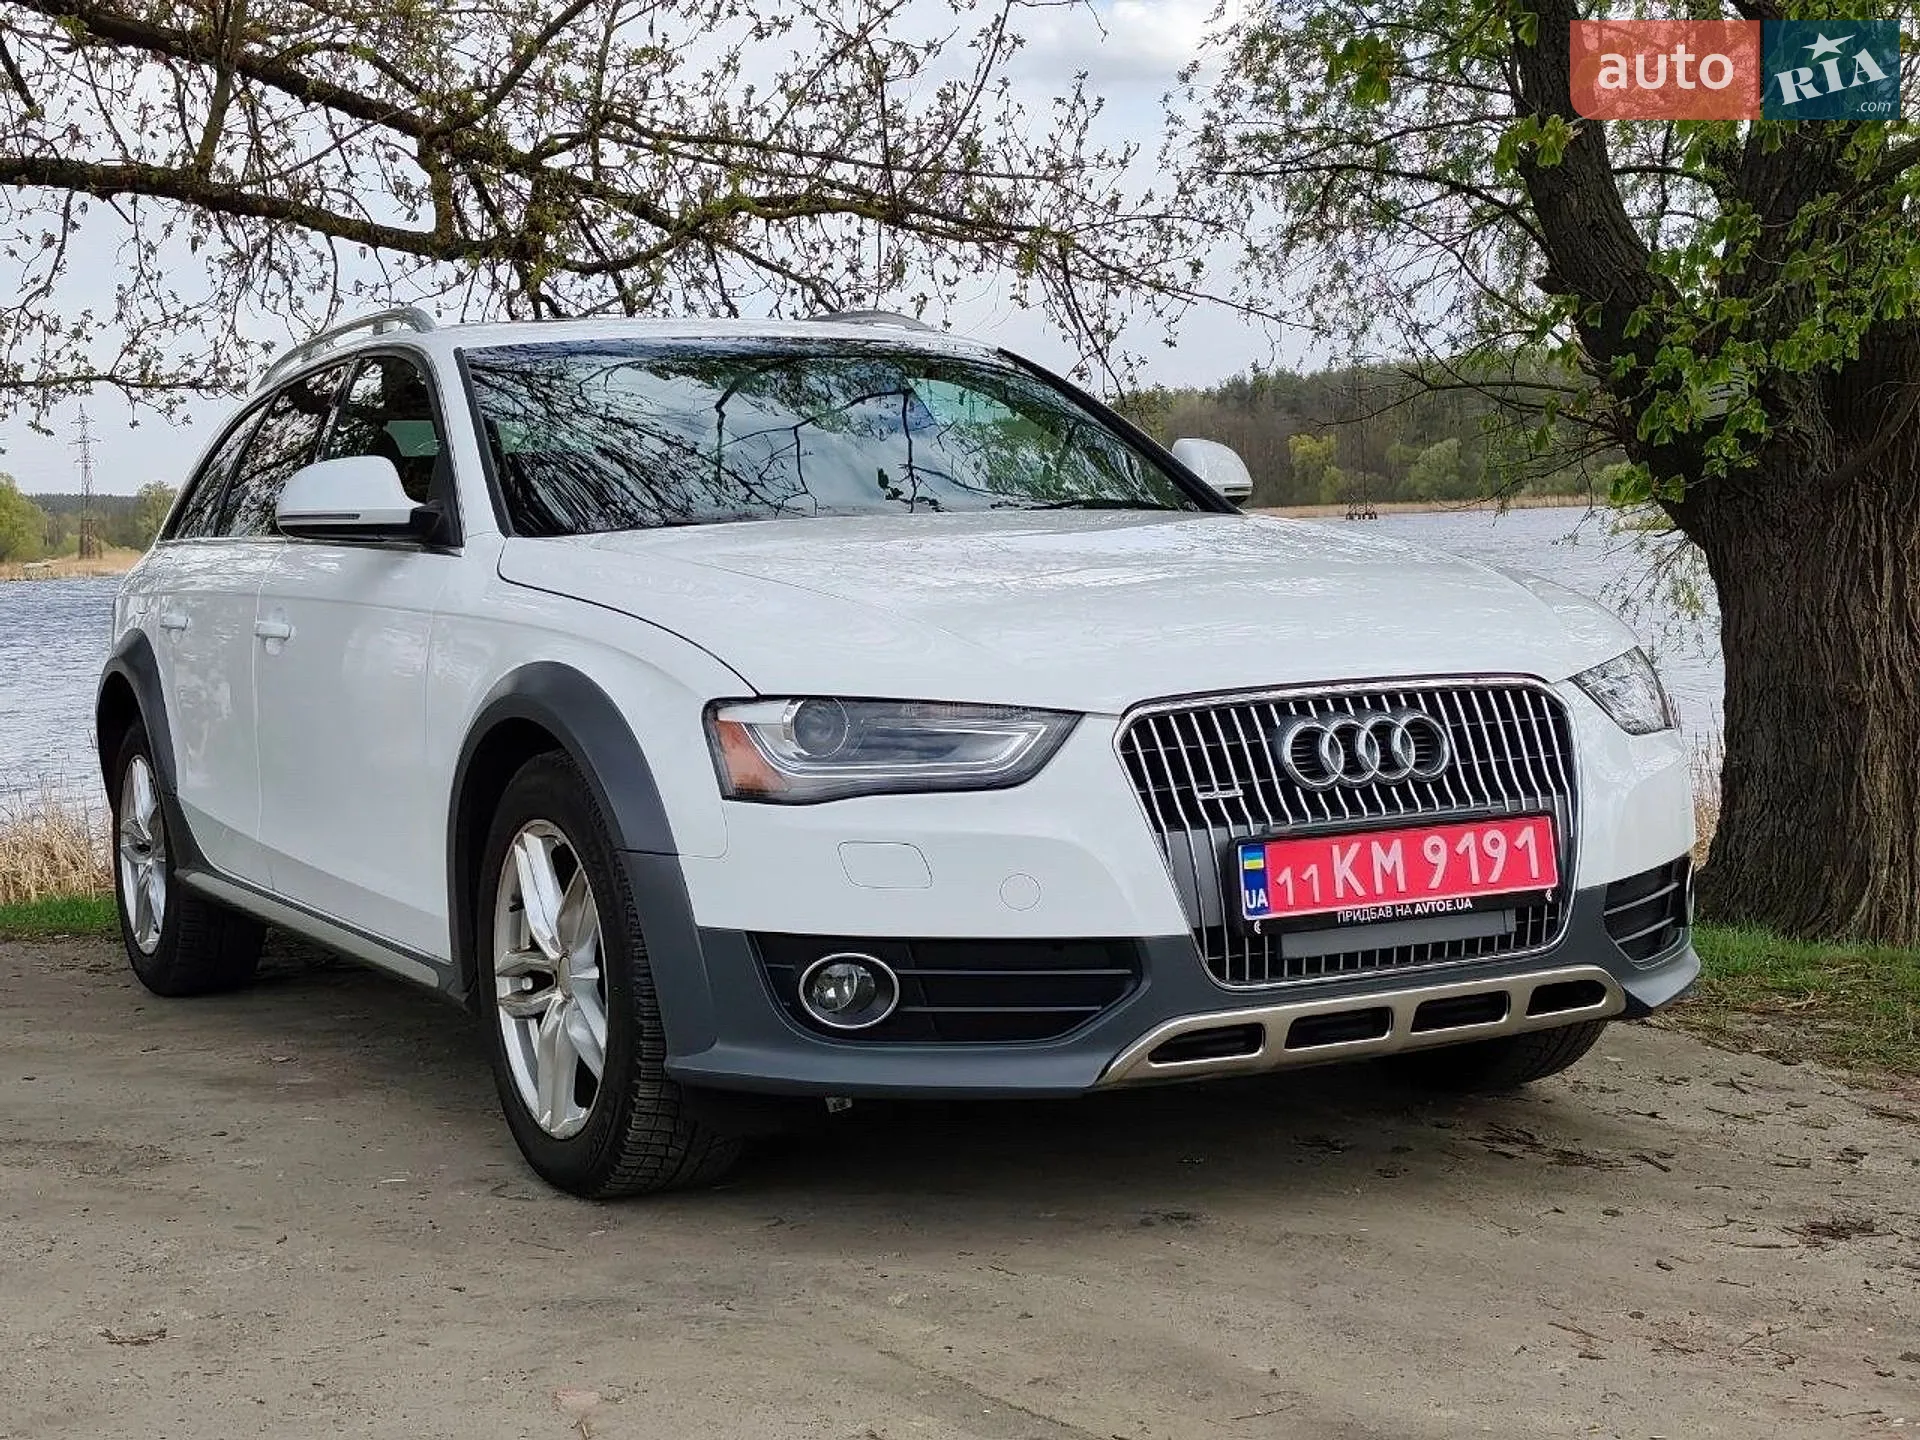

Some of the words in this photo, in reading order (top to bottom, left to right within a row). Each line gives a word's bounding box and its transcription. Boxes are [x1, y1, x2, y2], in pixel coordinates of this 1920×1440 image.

[1275, 865, 1320, 906] 11
[1332, 839, 1407, 898] KM
[1423, 826, 1539, 889] 9191
[1245, 888, 1269, 910] UA
[1337, 906, 1393, 923] ПРИДБАВ
[1396, 904, 1412, 917] НА
[1415, 899, 1473, 915] AVTOE.UA
